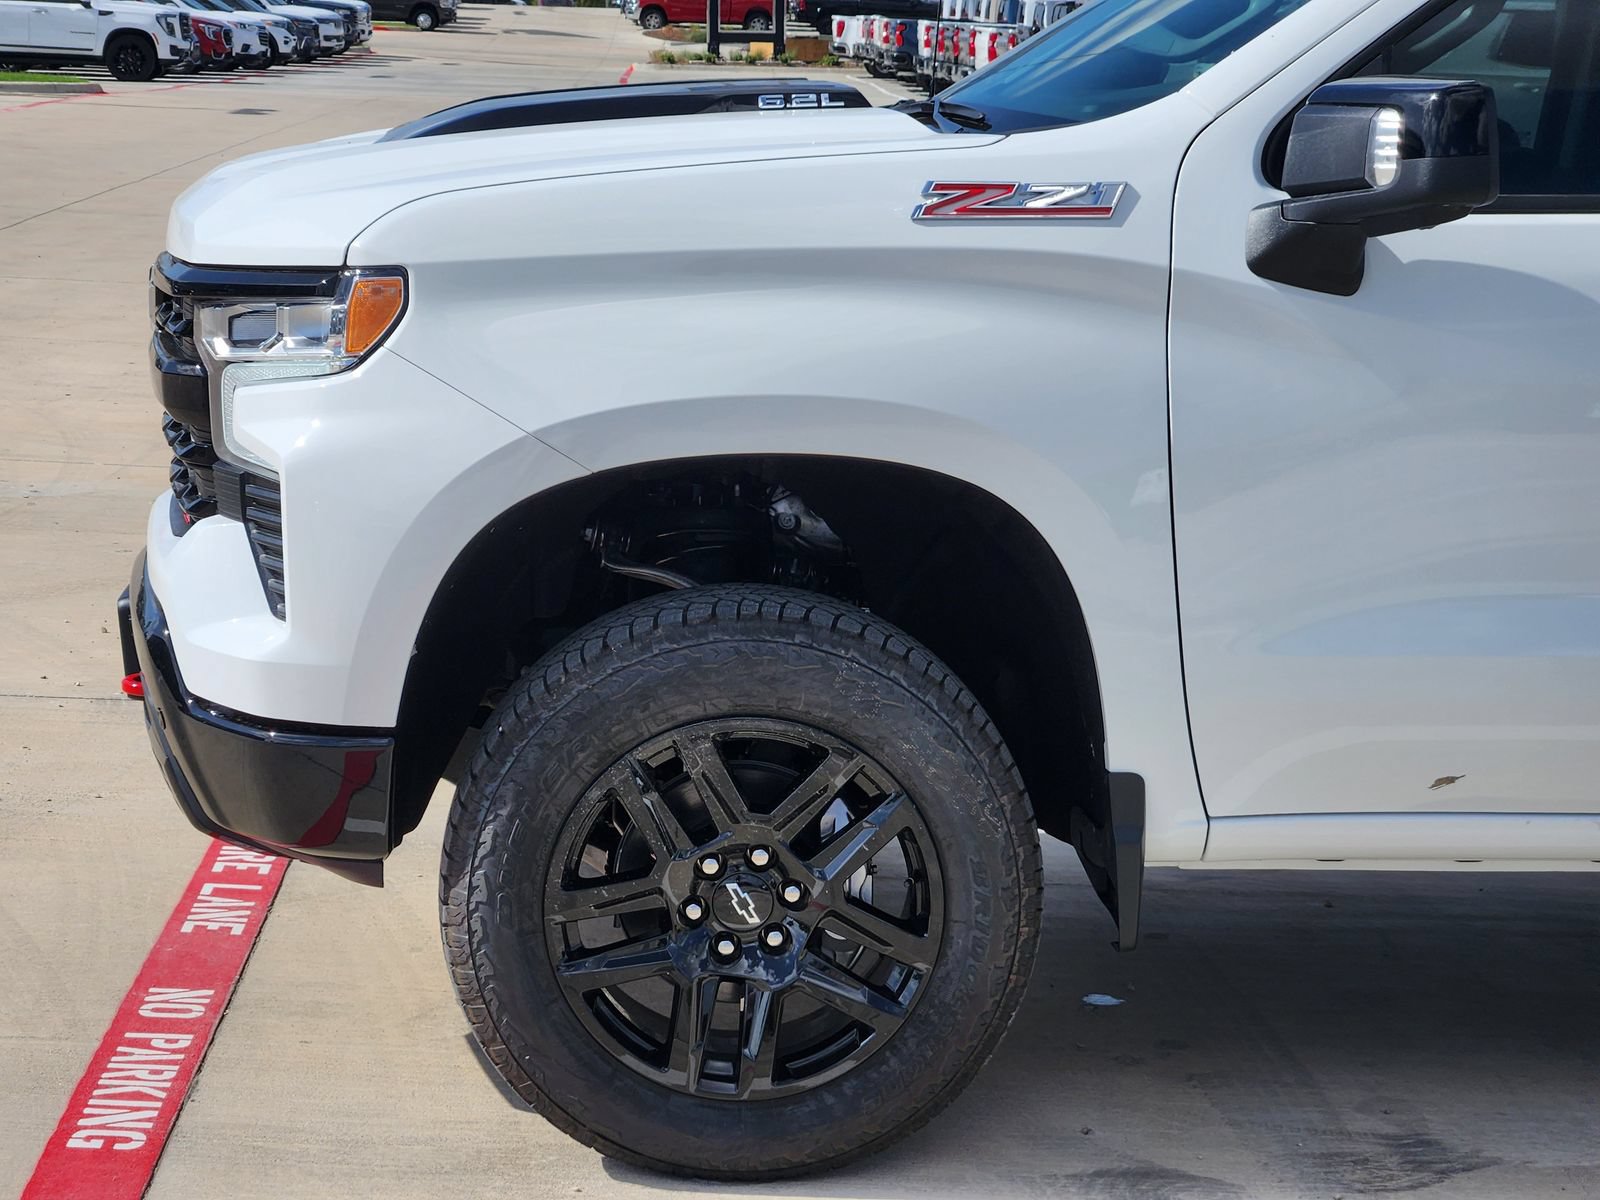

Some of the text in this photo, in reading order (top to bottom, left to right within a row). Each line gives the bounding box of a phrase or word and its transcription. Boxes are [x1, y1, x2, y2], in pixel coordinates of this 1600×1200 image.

[758, 93, 845, 109] 6.2L
[911, 181, 1127, 220] Z71
[66, 845, 278, 1151] RE LANE NO PARKING
